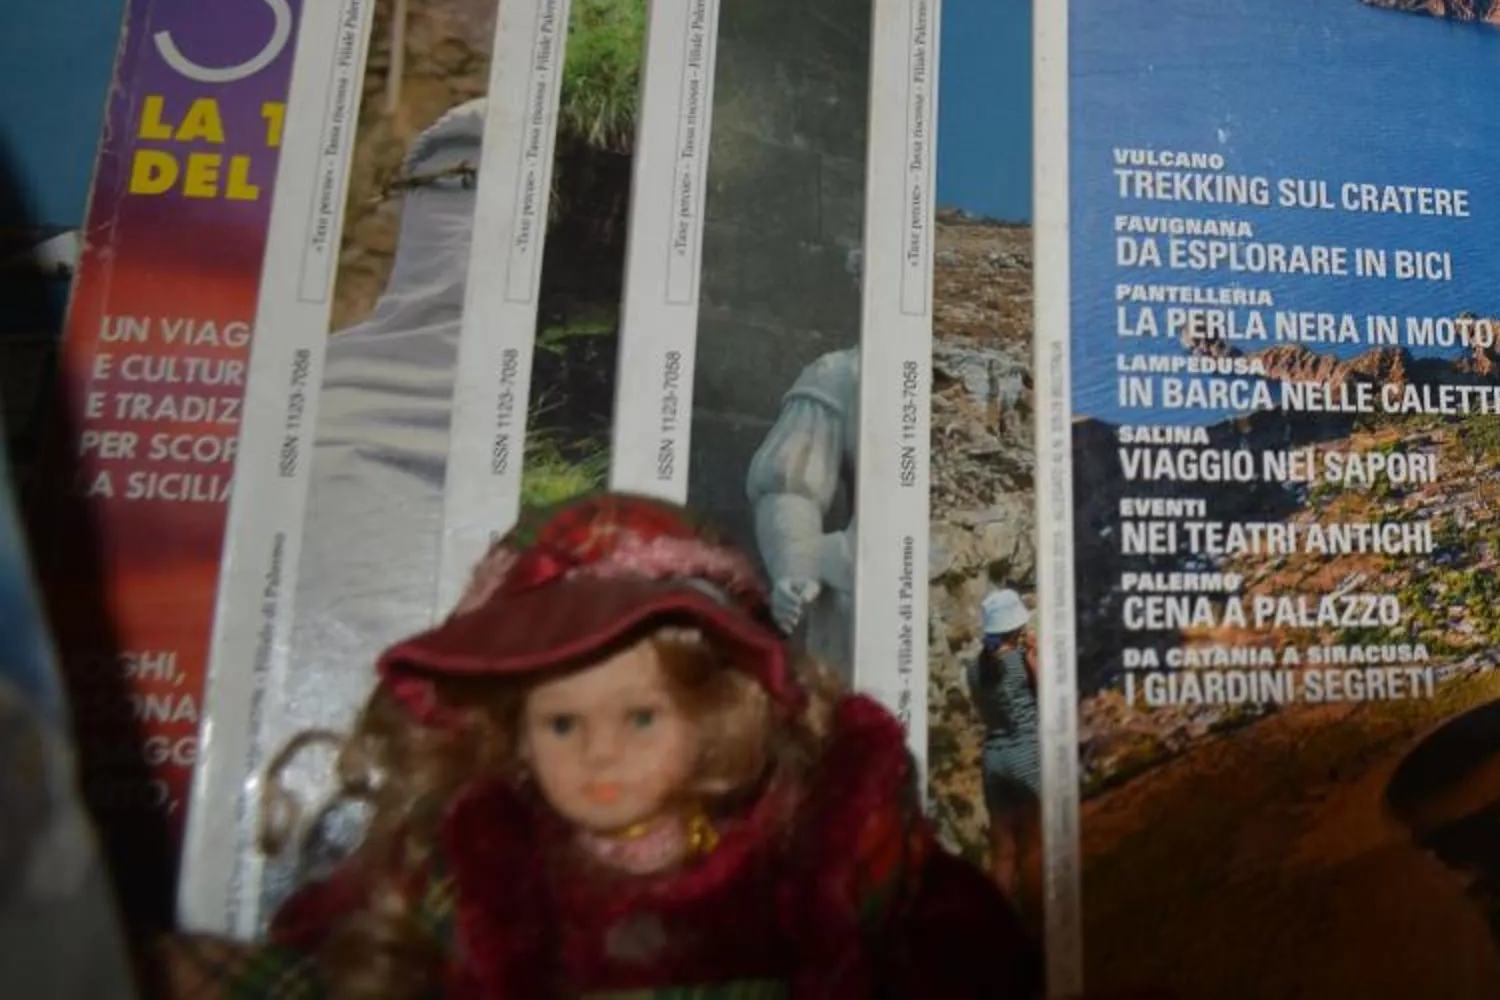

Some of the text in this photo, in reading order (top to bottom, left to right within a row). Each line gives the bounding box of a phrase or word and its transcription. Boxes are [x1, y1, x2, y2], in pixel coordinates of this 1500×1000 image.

[138, 94, 226, 144] LA
[127, 147, 261, 201] DEL
[1113, 147, 1225, 170] VULCANO
[1114, 169, 1471, 218] TREKKING SUL CRATERE
[1115, 215, 1253, 238] FAVIGNANA
[1116, 237, 1452, 281] DA ESPLORARE IN BICI
[1115, 283, 1274, 307] PANTELLERIA
[100, 314, 250, 348] UN VIAG
[1117, 306, 1495, 350] LA PERLA NERA IN MOTO
[92, 352, 244, 386] E CULTUR
[1117, 353, 1265, 376] LAMPEDUSA
[84, 391, 241, 424] E TRADIZ
[1119, 376, 1153, 409] IN
[1162, 377, 1277, 411] BARCA
[1281, 380, 1374, 413] NELLE
[655, 348, 683, 482] ISSN 1123-7058
[900, 359, 918, 488] ISSN 1123-7058
[80, 429, 141, 461] PER
[1118, 425, 1210, 445] SALINA
[278, 432, 301, 478] ISSN
[491, 433, 510, 476] ISSN
[1118, 447, 1437, 484] VIAGGIO NEI SAPORI
[1119, 498, 1207, 518] EVENTI
[1121, 521, 1433, 555] NEI TEATRI ANTICHI
[899, 535, 916, 602] Palermo
[1121, 572, 1242, 591] PALERMO
[900, 603, 914, 621] di
[1123, 594, 1400, 630] CENA A PALAZZO
[898, 622, 914, 675] Filiale
[1123, 643, 1429, 668] DA CATANIA A SIRACUSA
[1125, 667, 1434, 706] I GIARDINI SEGRETI
